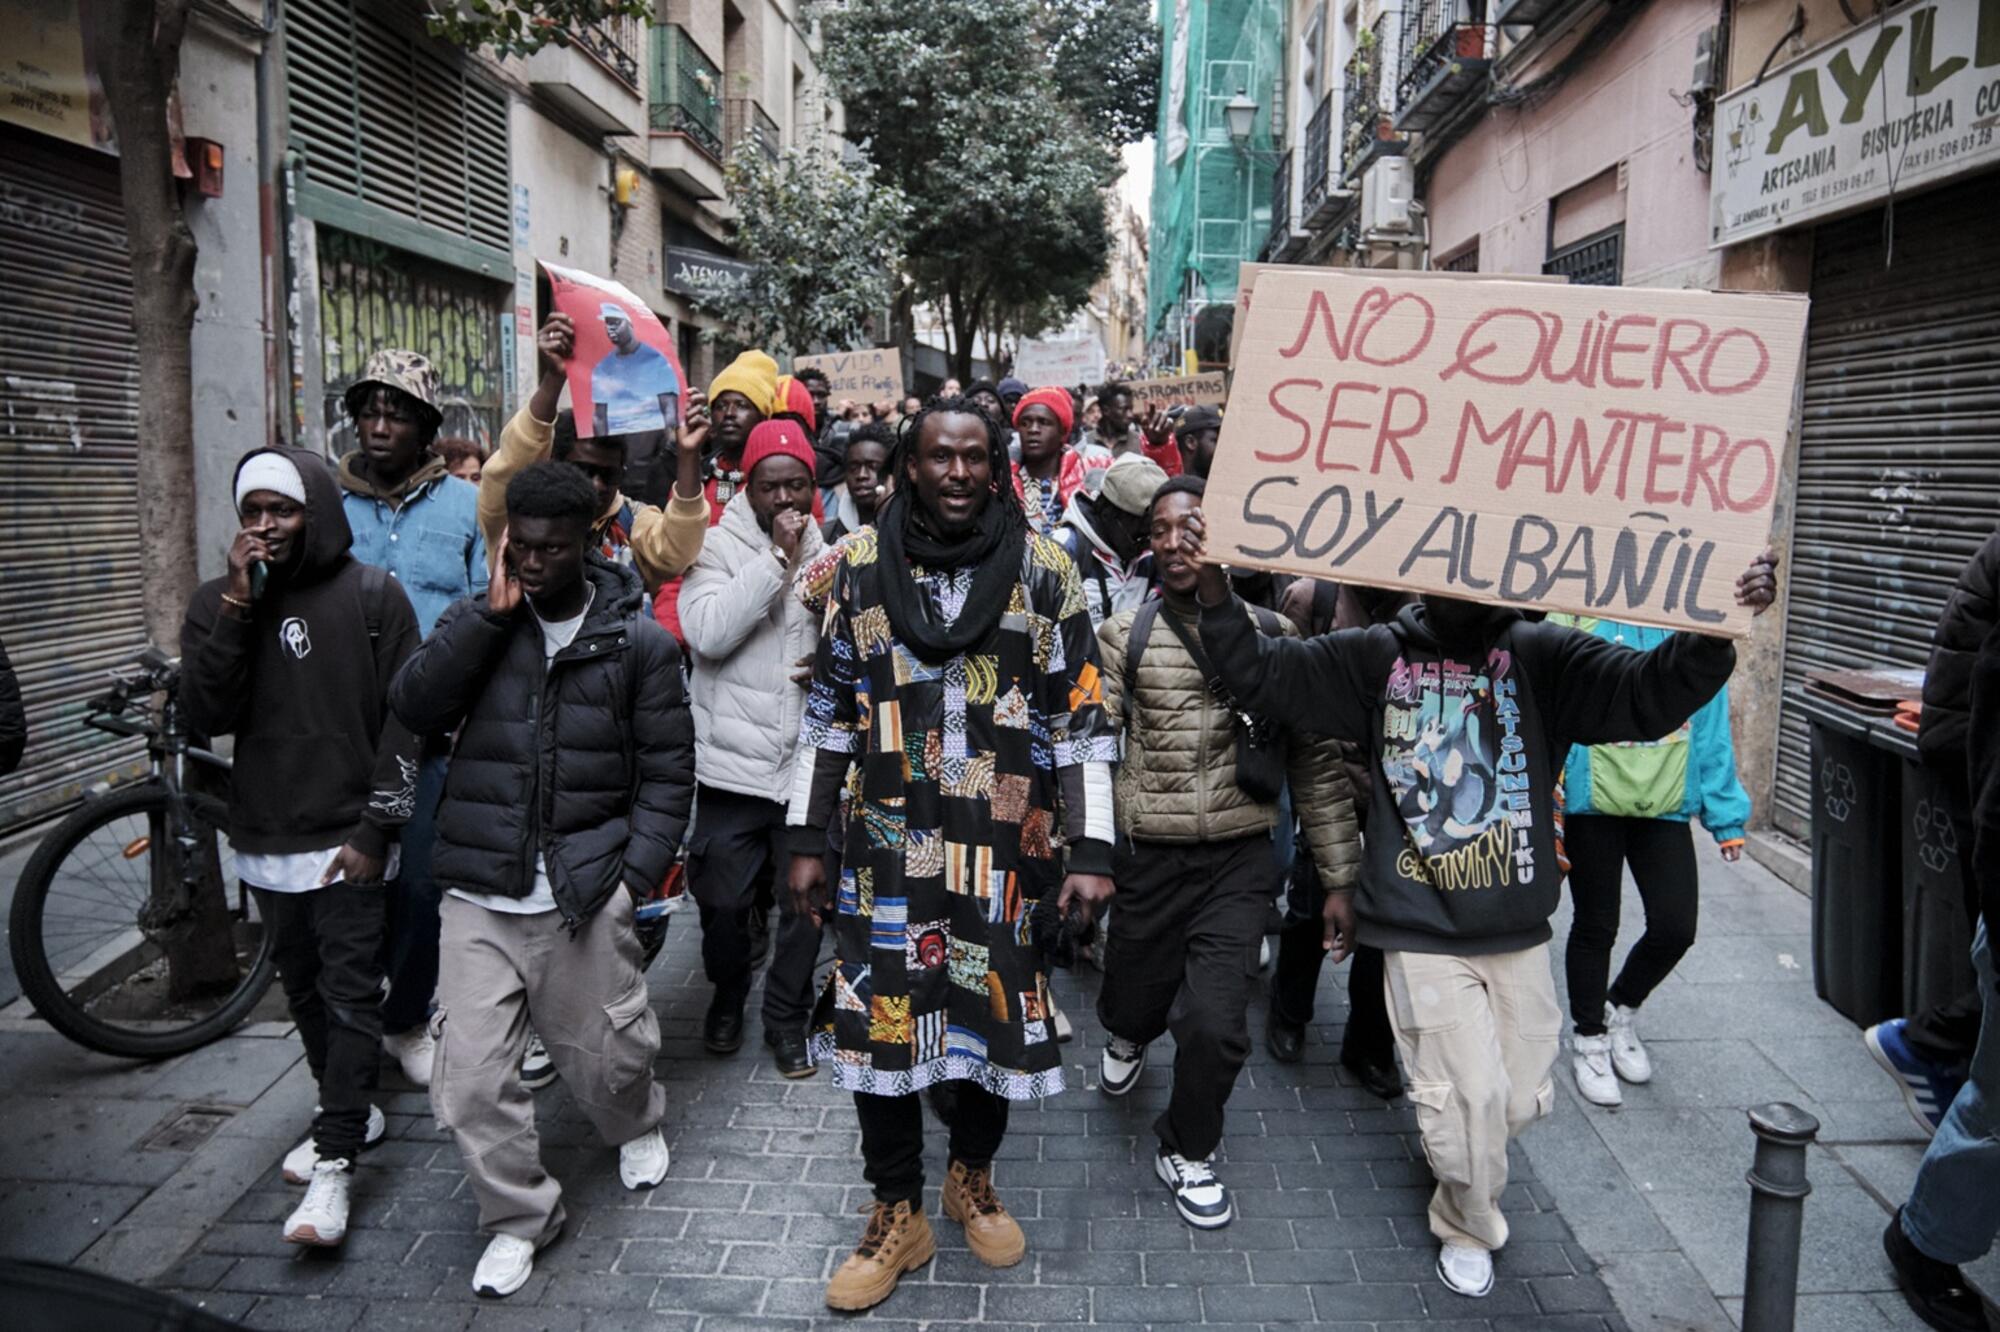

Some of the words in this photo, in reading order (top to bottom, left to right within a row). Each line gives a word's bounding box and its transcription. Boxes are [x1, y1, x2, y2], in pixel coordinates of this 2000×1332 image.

[1760, 144, 1837, 196] ARTESANIA
[1860, 98, 1954, 160] BISUTERIA
[1904, 152, 1921, 172] FAX
[831, 353, 884, 373] VIDA
[1278, 286, 1436, 367] NO
[1149, 379, 1223, 398] FRONTERAS
[1254, 378, 1429, 482] SER
[1440, 399, 1777, 513] MANTERO
[1235, 475, 1404, 568] SOY
